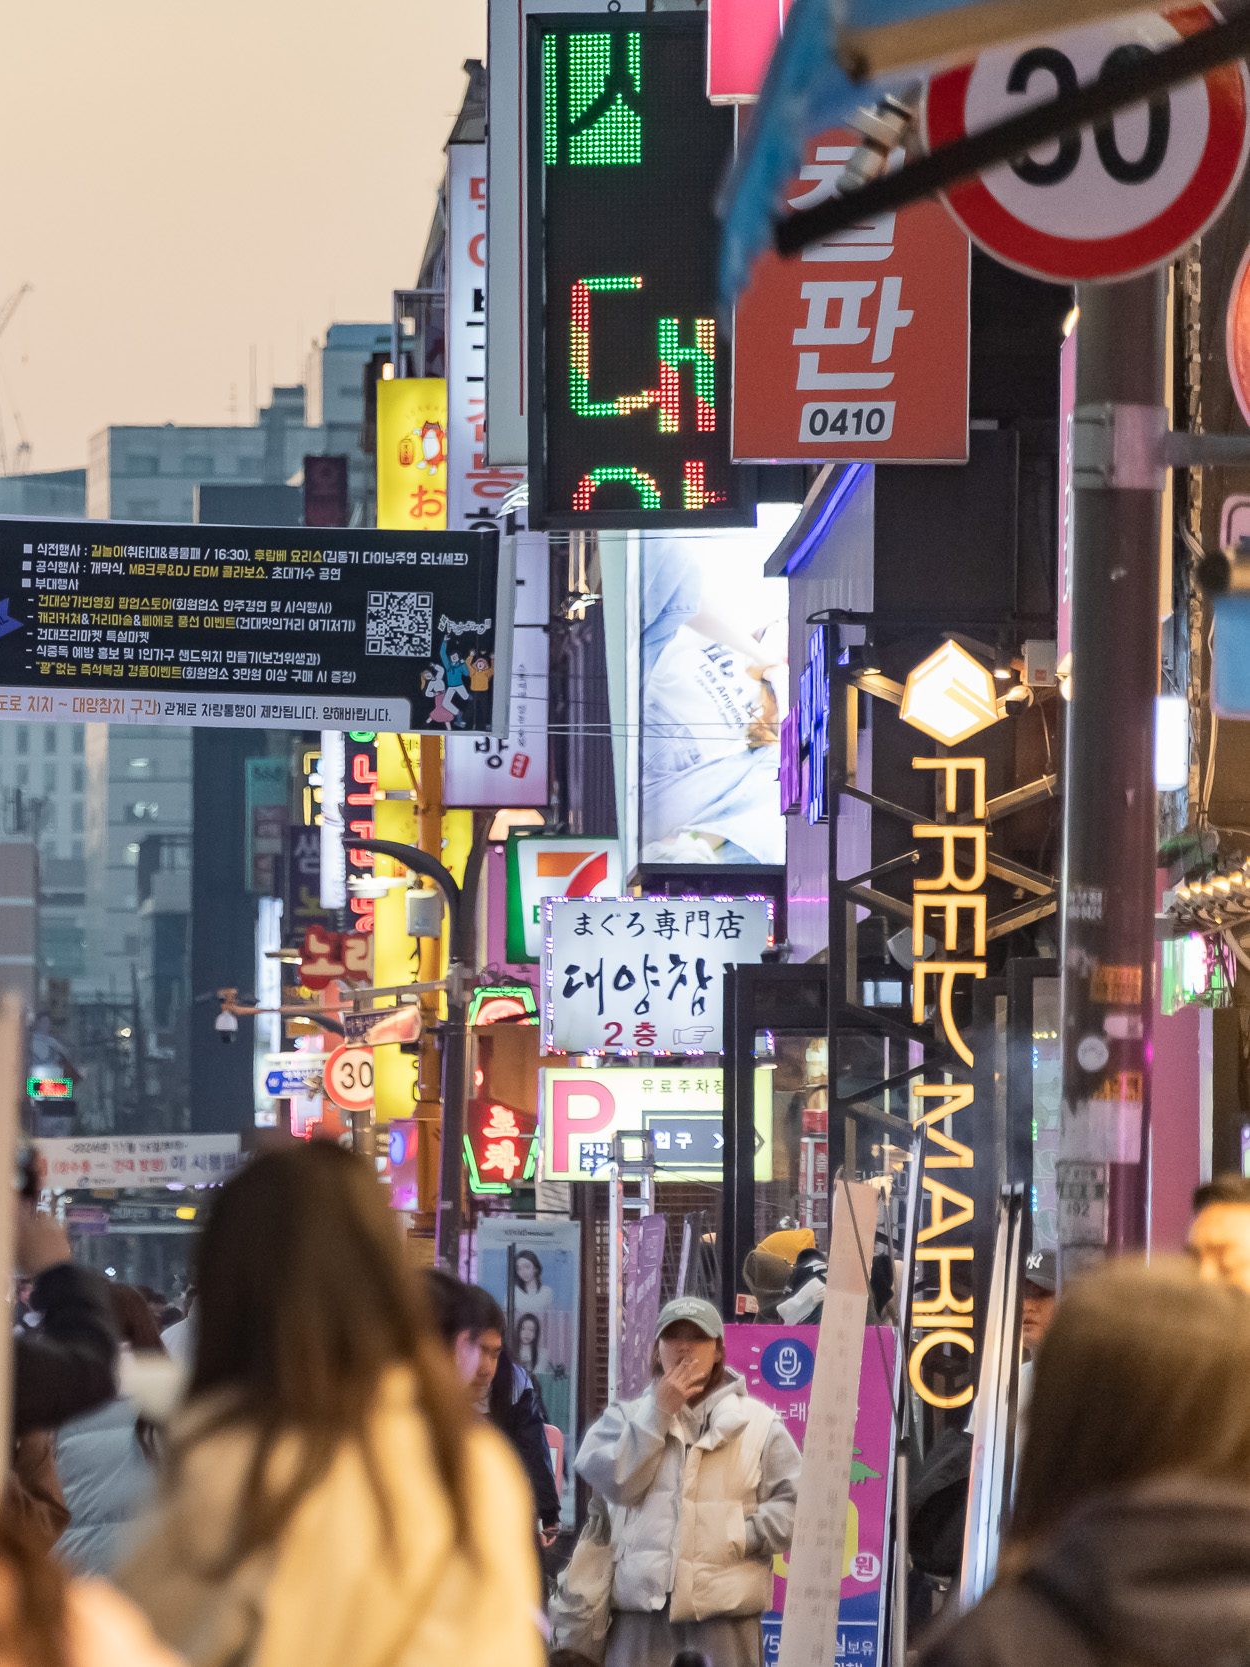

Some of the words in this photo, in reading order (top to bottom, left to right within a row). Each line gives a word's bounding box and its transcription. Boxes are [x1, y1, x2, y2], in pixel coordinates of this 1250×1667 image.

[1005, 44, 1172, 187] 30
[807, 407, 886, 437] 0410
[37, 543, 81, 558] 식전행사
[36, 560, 80, 574] 공식행사
[194, 565, 219, 578] EDM
[271, 566, 316, 580] 초대가수
[319, 567, 342, 581] 공연
[35, 577, 79, 591] 부대행사
[38, 594, 115, 609] 건대상가번영회
[223, 599, 267, 613] 안주경연
[270, 600, 281, 613] 및
[177, 614, 200, 629] 풍선
[37, 628, 102, 643] 건대프리마켓
[36, 644, 69, 658] 식중독
[72, 646, 94, 660] 예방
[97, 647, 120, 661] 홍보
[123, 648, 134, 661] 및
[137, 648, 175, 662] 1인가구
[178, 649, 222, 663] 샌드위치
[80, 663, 125, 678] 즉석복권
[232, 667, 262, 682] 3만원
[265, 668, 288, 683] 이상
[291, 669, 313, 684] 구매
[316, 670, 328, 684] 시
[72, 696, 126, 716] 대양참치
[130, 699, 162, 716] 구간)
[164, 702, 198, 717] 관계로
[201, 703, 256, 719] 차량통행이
[260, 704, 319, 720] 제한됩니다.
[323, 706, 392, 722] 양해바랍니다.
[573, 909, 745, 940] まぐろ専門店
[341, 1062, 373, 1090] 30
[552, 1079, 617, 1173] P
[654, 1132, 693, 1151] 입구
